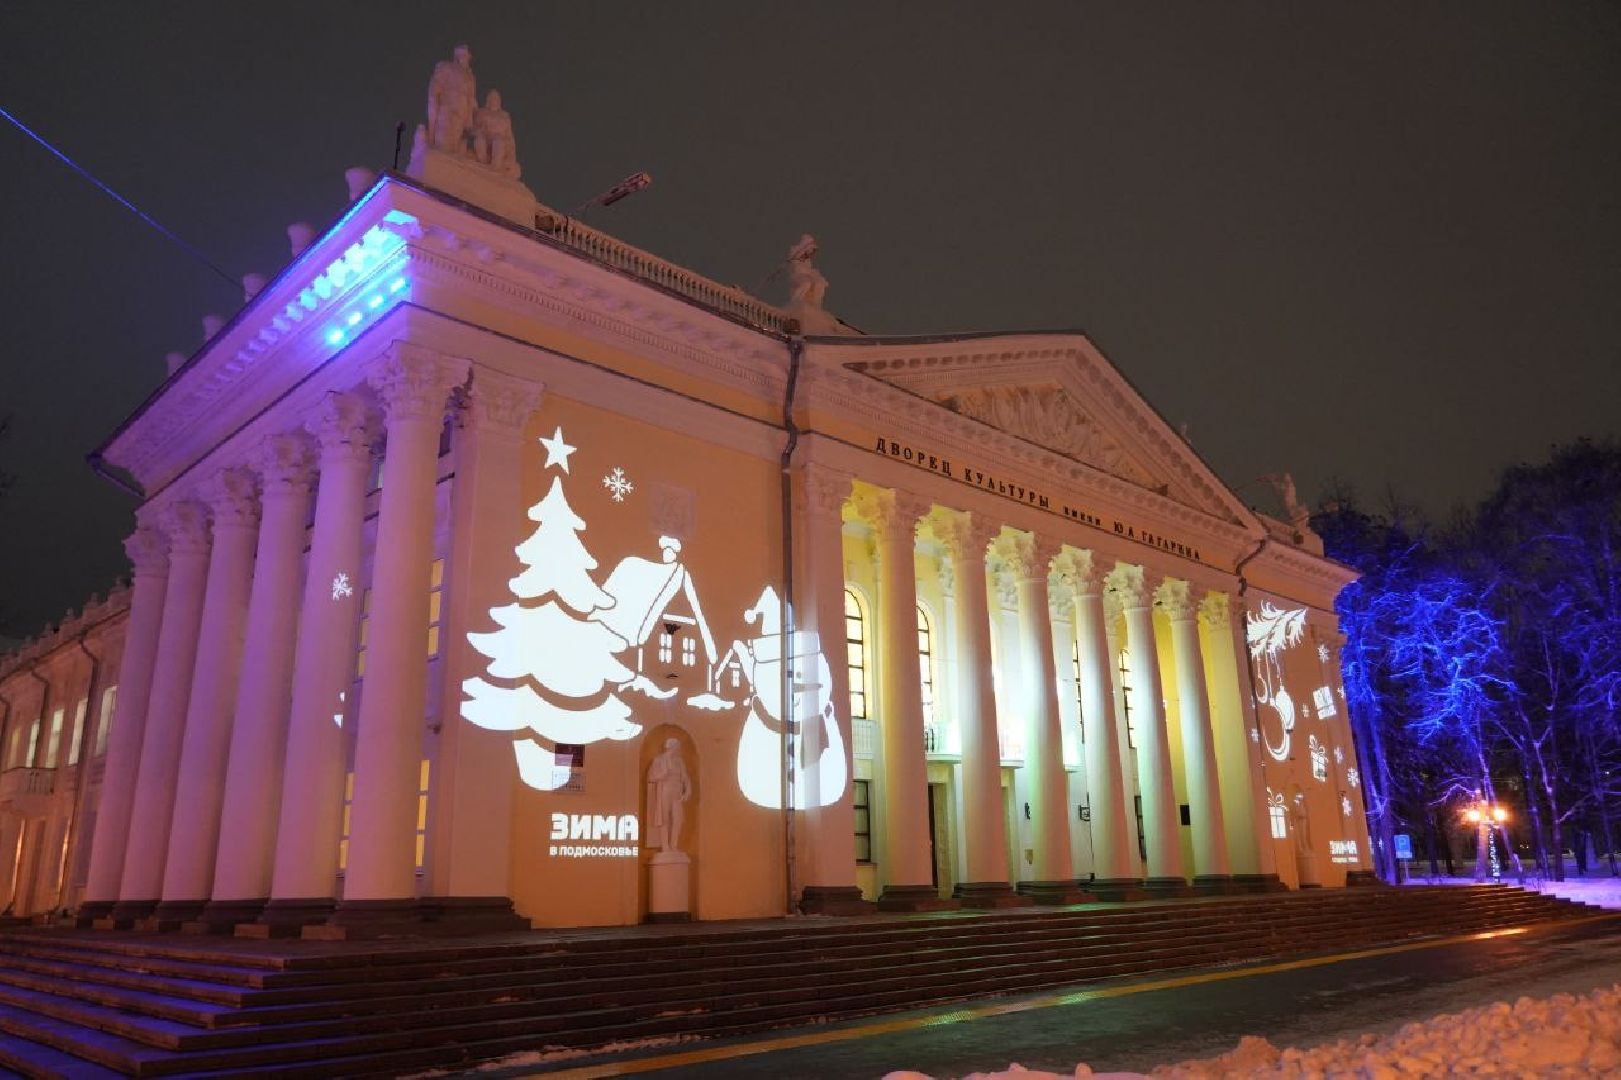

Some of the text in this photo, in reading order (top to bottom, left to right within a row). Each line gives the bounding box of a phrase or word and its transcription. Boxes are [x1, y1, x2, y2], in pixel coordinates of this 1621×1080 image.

[876, 438, 951, 476] ДВОРЕЦ
[964, 468, 1049, 508] КУЛЬТУРЫ
[551, 813, 639, 840] ЗИМА
[560, 846, 638, 858] ПОДМОСКОВЬЕ
